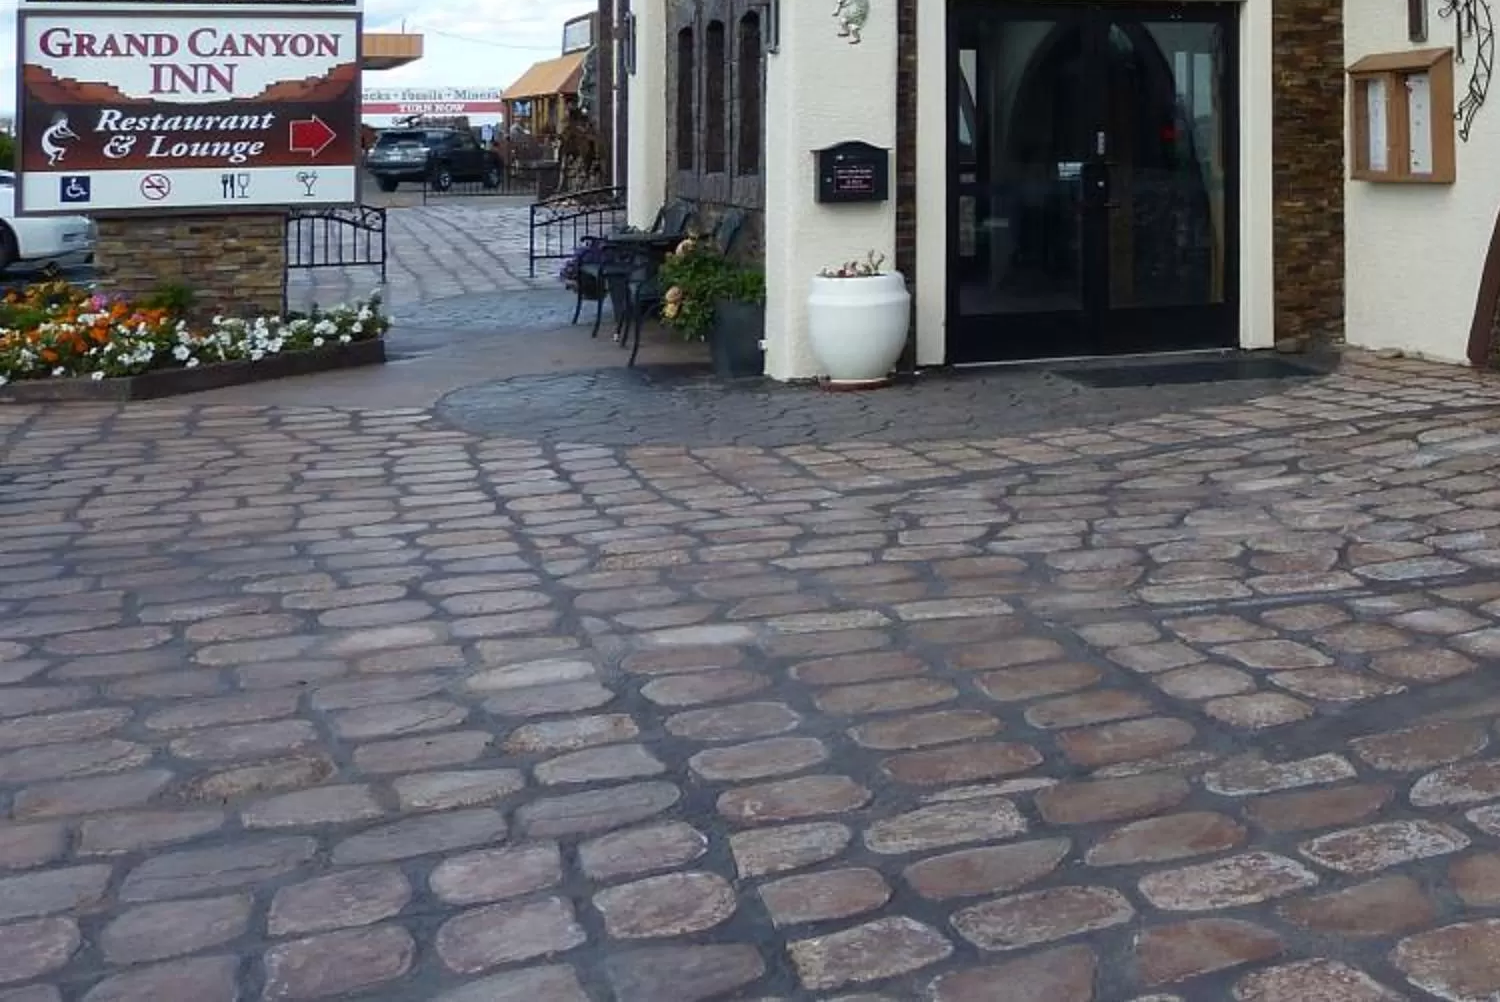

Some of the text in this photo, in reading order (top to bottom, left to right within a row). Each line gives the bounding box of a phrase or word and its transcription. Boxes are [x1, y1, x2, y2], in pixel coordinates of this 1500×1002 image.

[39, 28, 342, 58] GRAND CANYON
[149, 63, 239, 94] INN
[95, 109, 277, 133] Restaurant
[103, 135, 266, 164] & Lounge
